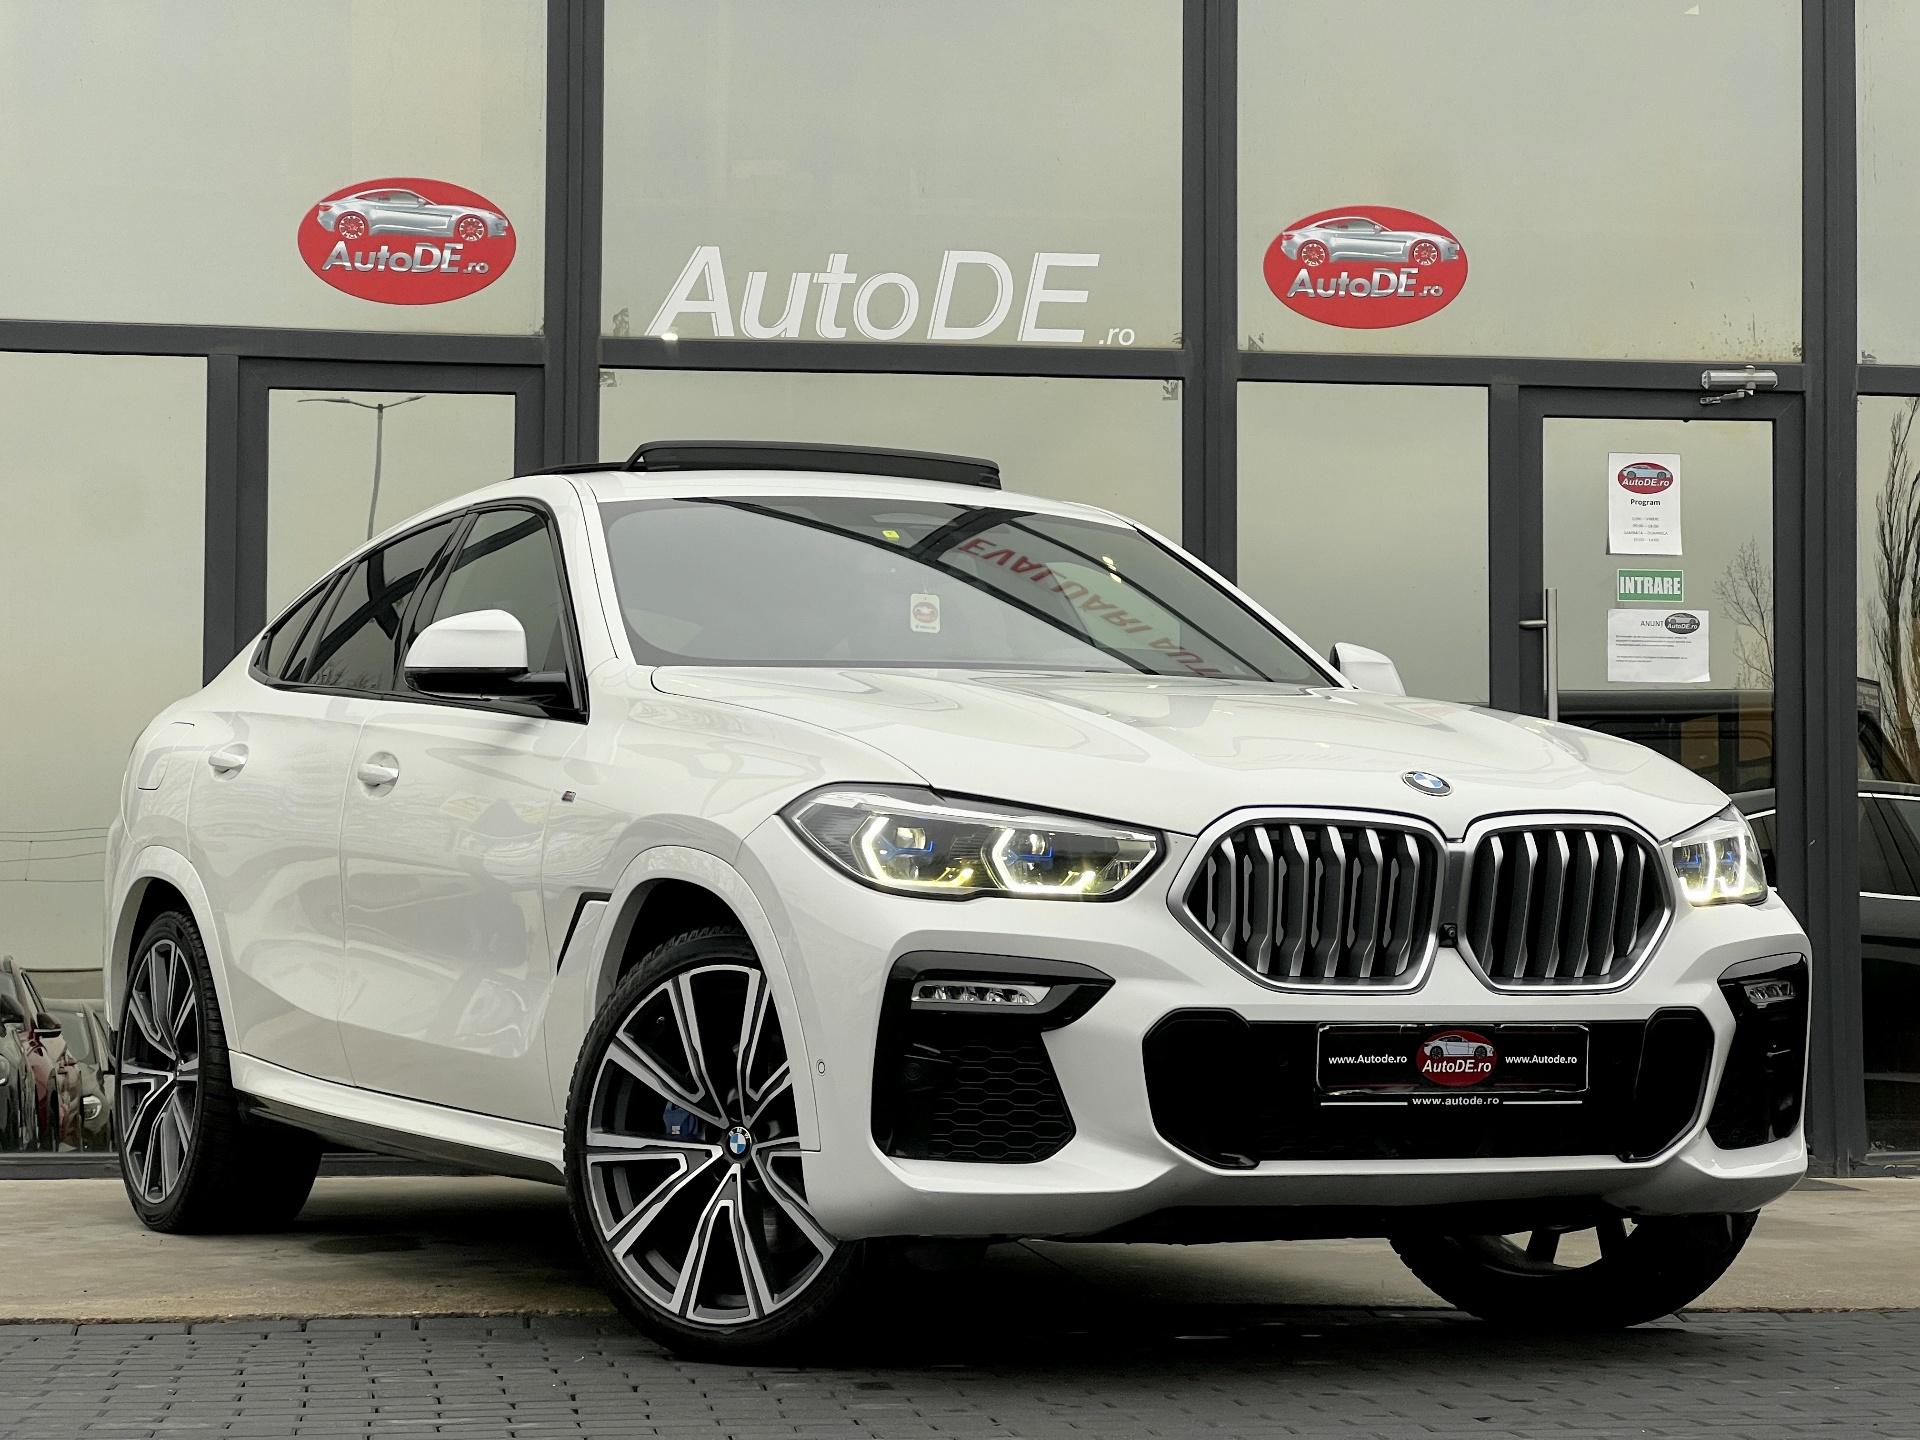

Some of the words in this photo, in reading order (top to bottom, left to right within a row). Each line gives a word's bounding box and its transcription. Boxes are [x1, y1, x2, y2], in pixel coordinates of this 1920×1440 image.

[321, 240, 464, 274] AutoDE
[463, 261, 489, 274] .ro
[1287, 267, 1419, 298] AutoDE
[644, 245, 1100, 343] AutoDE
[1098, 325, 1136, 347] .ro
[1622, 478, 1670, 487] AutoDE.ro
[1630, 498, 1661, 507] Program
[1619, 576, 1681, 595] INTRARE
[1328, 1054, 1408, 1065] www.Autode.ro
[1504, 1054, 1578, 1065] www.Autode.ro
[1421, 1059, 1492, 1073] AutoDE.ro
[1412, 1095, 1500, 1105] www.autode.ro
